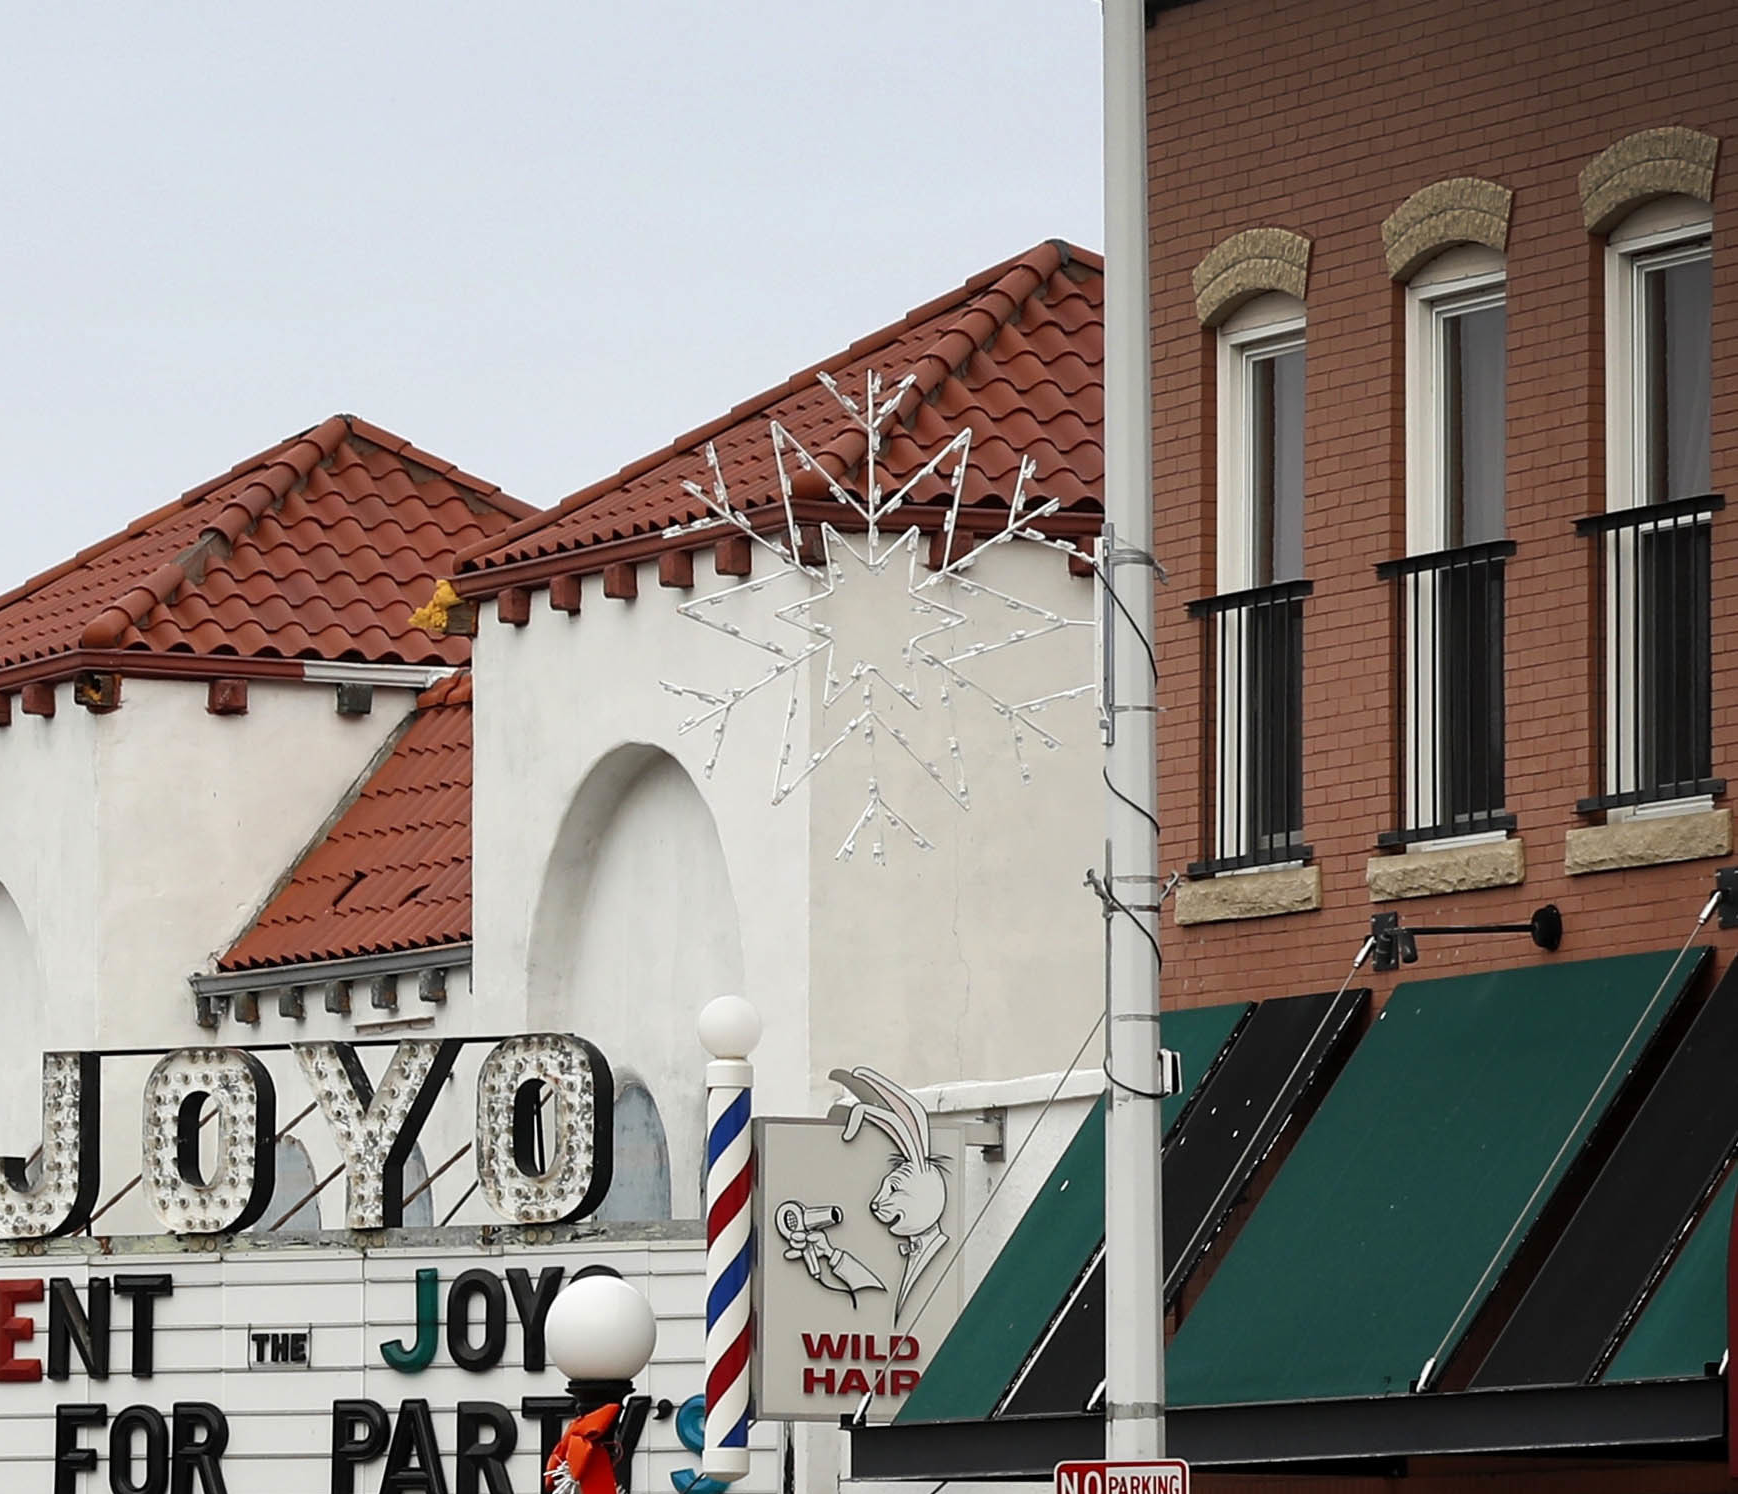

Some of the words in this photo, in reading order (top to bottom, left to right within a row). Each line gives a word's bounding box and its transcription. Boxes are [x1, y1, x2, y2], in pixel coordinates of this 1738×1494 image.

[251, 1331, 308, 1364] THE
[380, 1264, 624, 1374] JOY
[801, 1333, 920, 1361] WILD
[803, 1367, 921, 1396] HAIR
